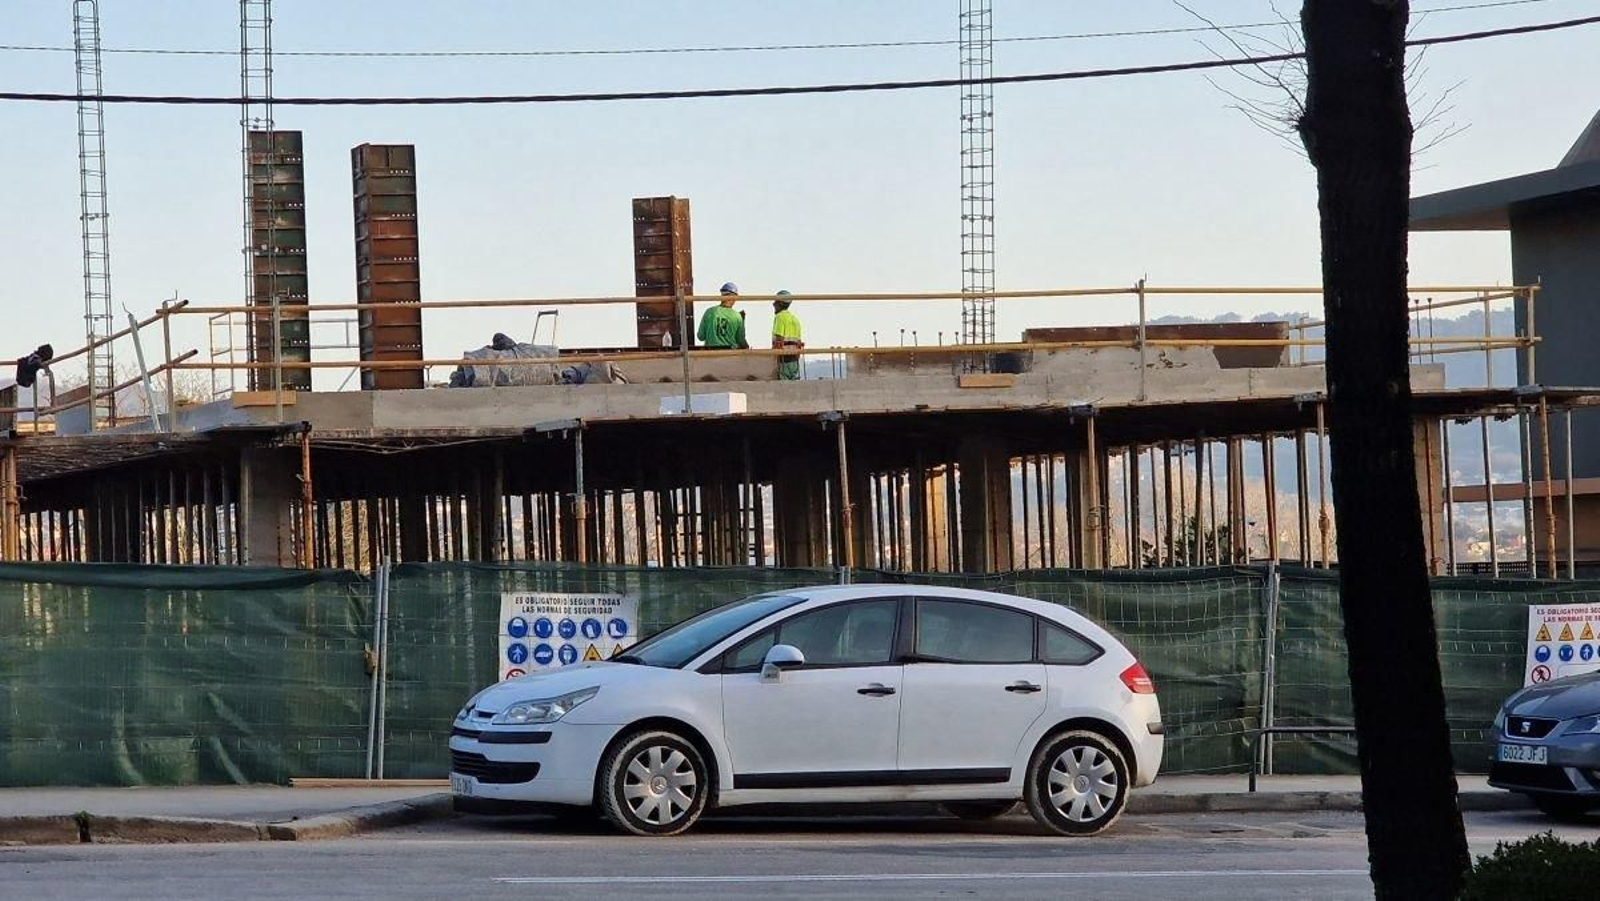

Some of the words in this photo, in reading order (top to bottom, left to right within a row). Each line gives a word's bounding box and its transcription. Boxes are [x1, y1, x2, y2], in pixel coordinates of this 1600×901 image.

[515, 596, 523, 604] ES
[525, 597, 567, 605] OBLIGATORIO
[570, 598, 595, 606] SEGUIR
[598, 598, 621, 606] TODAS
[537, 606, 562, 614] NORMAS
[1504, 746, 1524, 760] 6022
